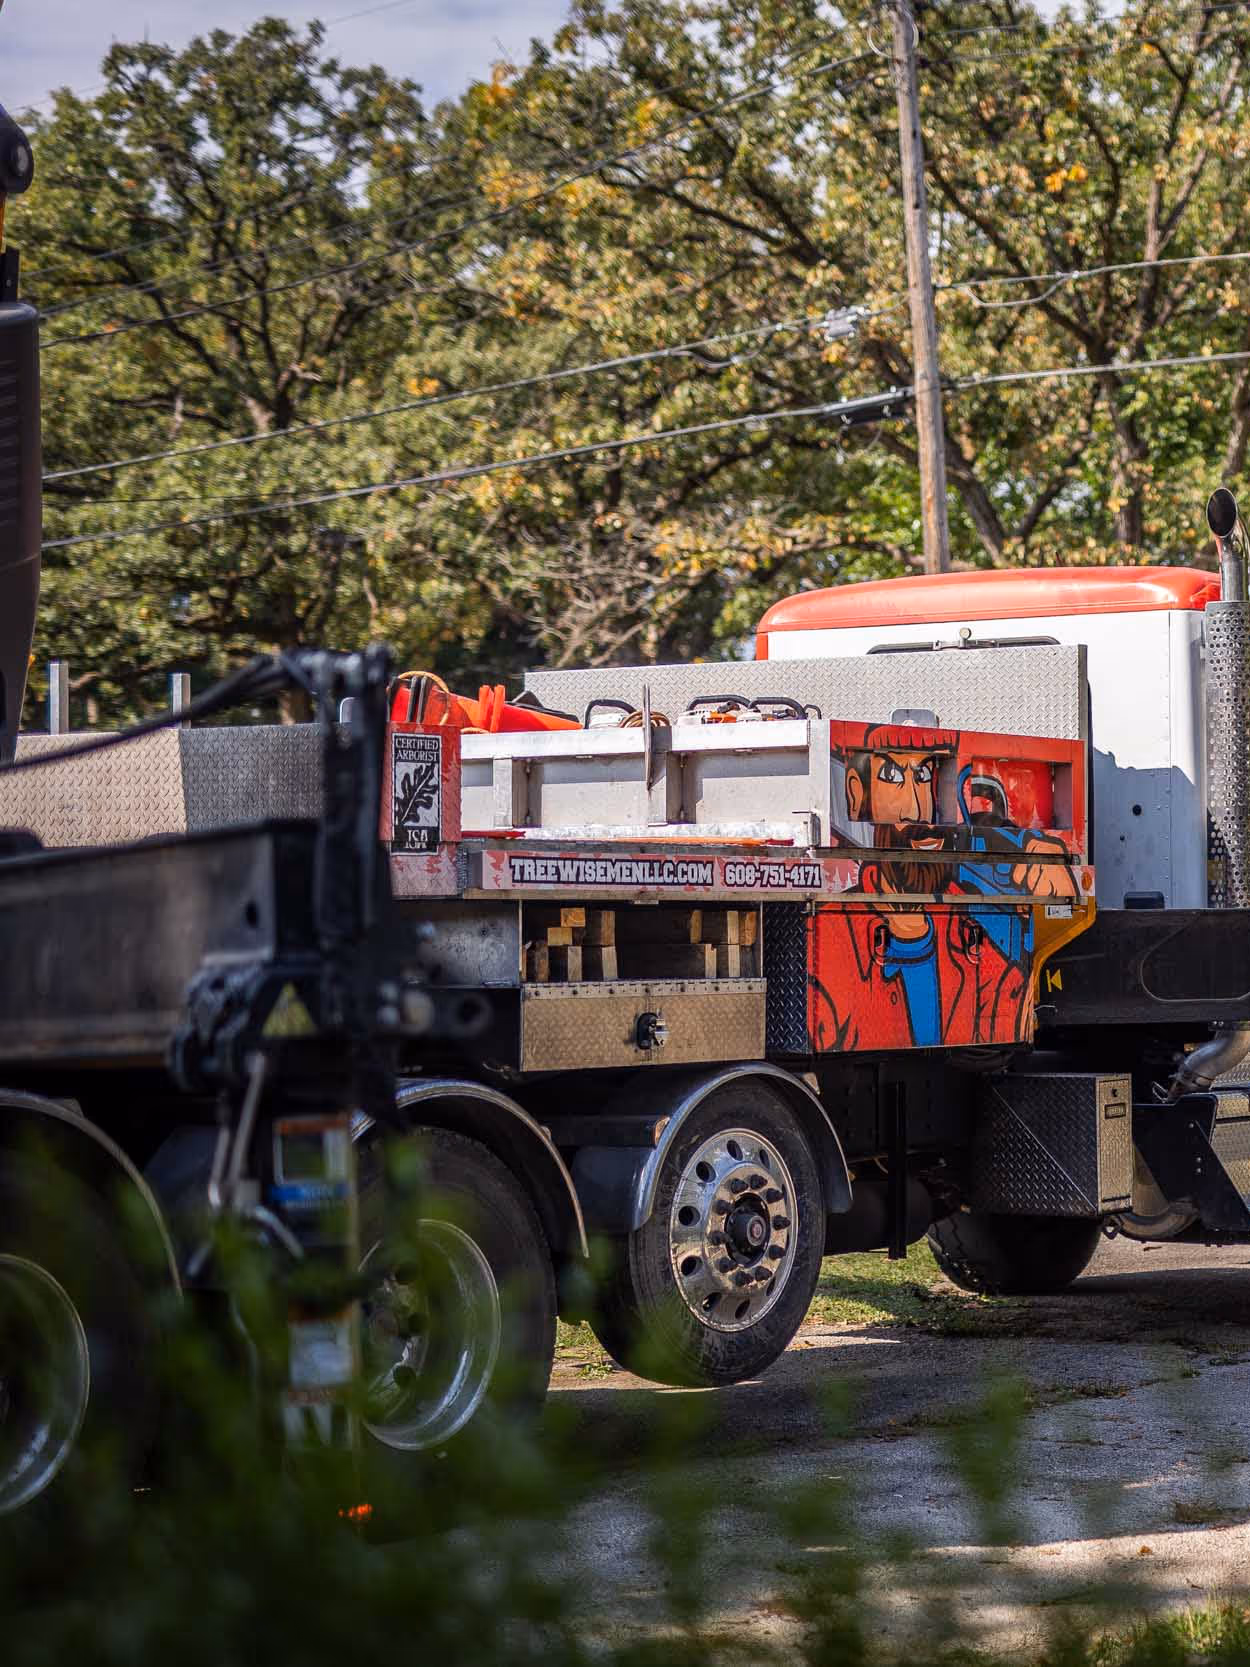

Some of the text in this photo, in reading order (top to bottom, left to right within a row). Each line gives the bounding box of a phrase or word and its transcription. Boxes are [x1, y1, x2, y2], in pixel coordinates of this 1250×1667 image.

[395, 738, 439, 750] CERTIFIED
[396, 750, 439, 761] ARBORIST
[405, 829, 428, 849] ISA
[510, 857, 821, 887] TREEWISEMENLLC.COM 608-751-4171
